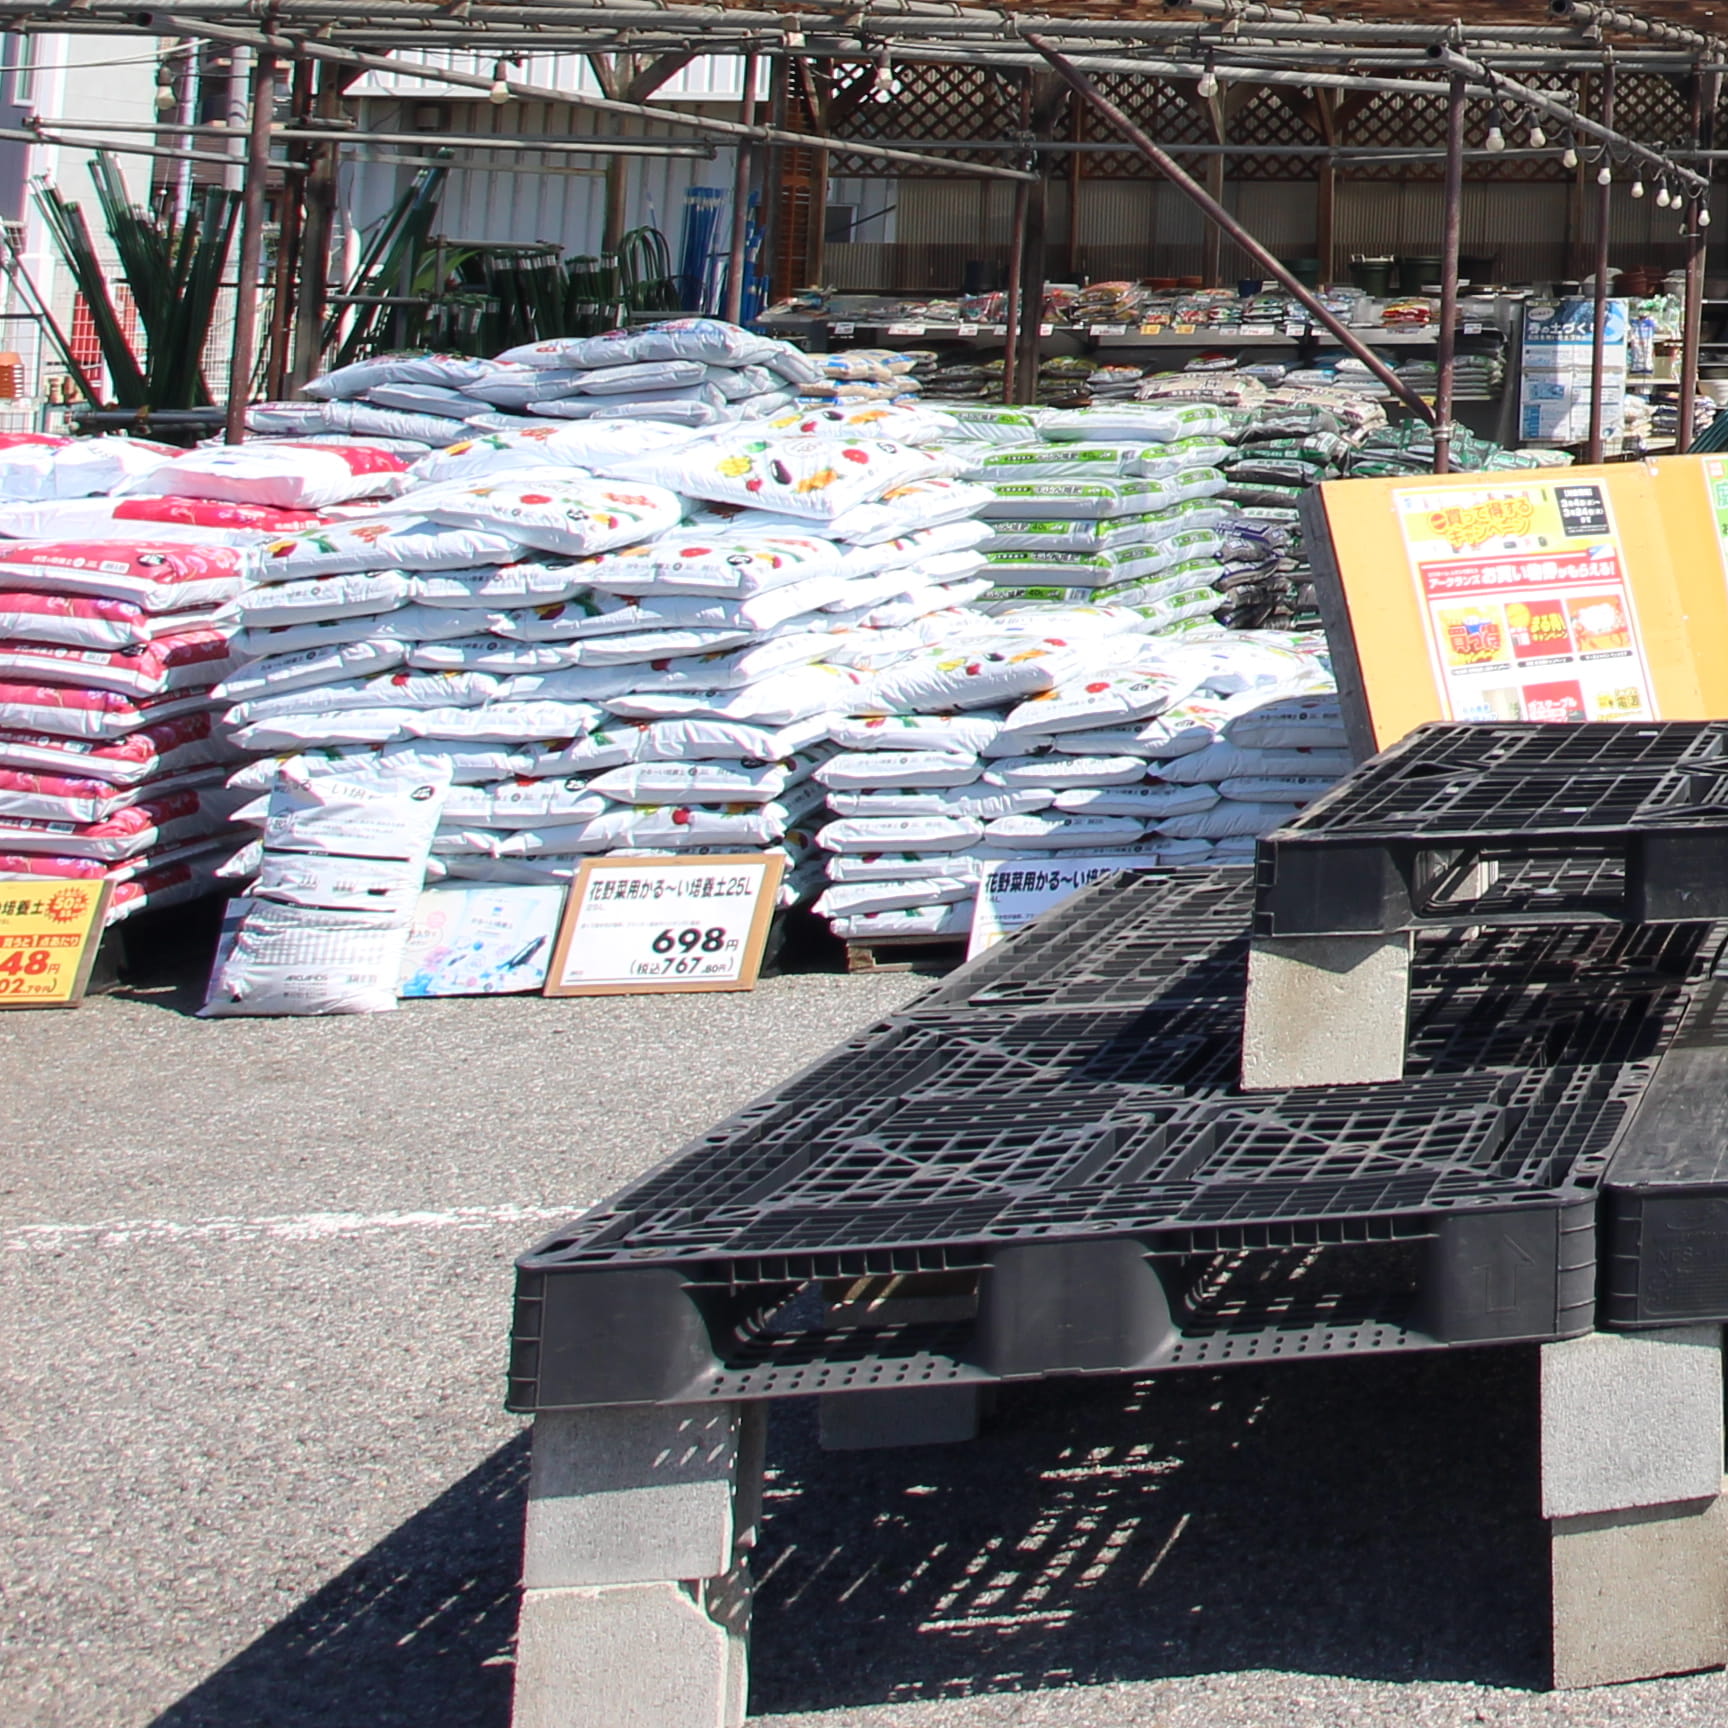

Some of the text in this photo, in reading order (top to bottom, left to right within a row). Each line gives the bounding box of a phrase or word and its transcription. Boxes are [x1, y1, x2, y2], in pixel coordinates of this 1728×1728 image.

[985, 867, 1121, 893] 花野菜用かる〜い培
